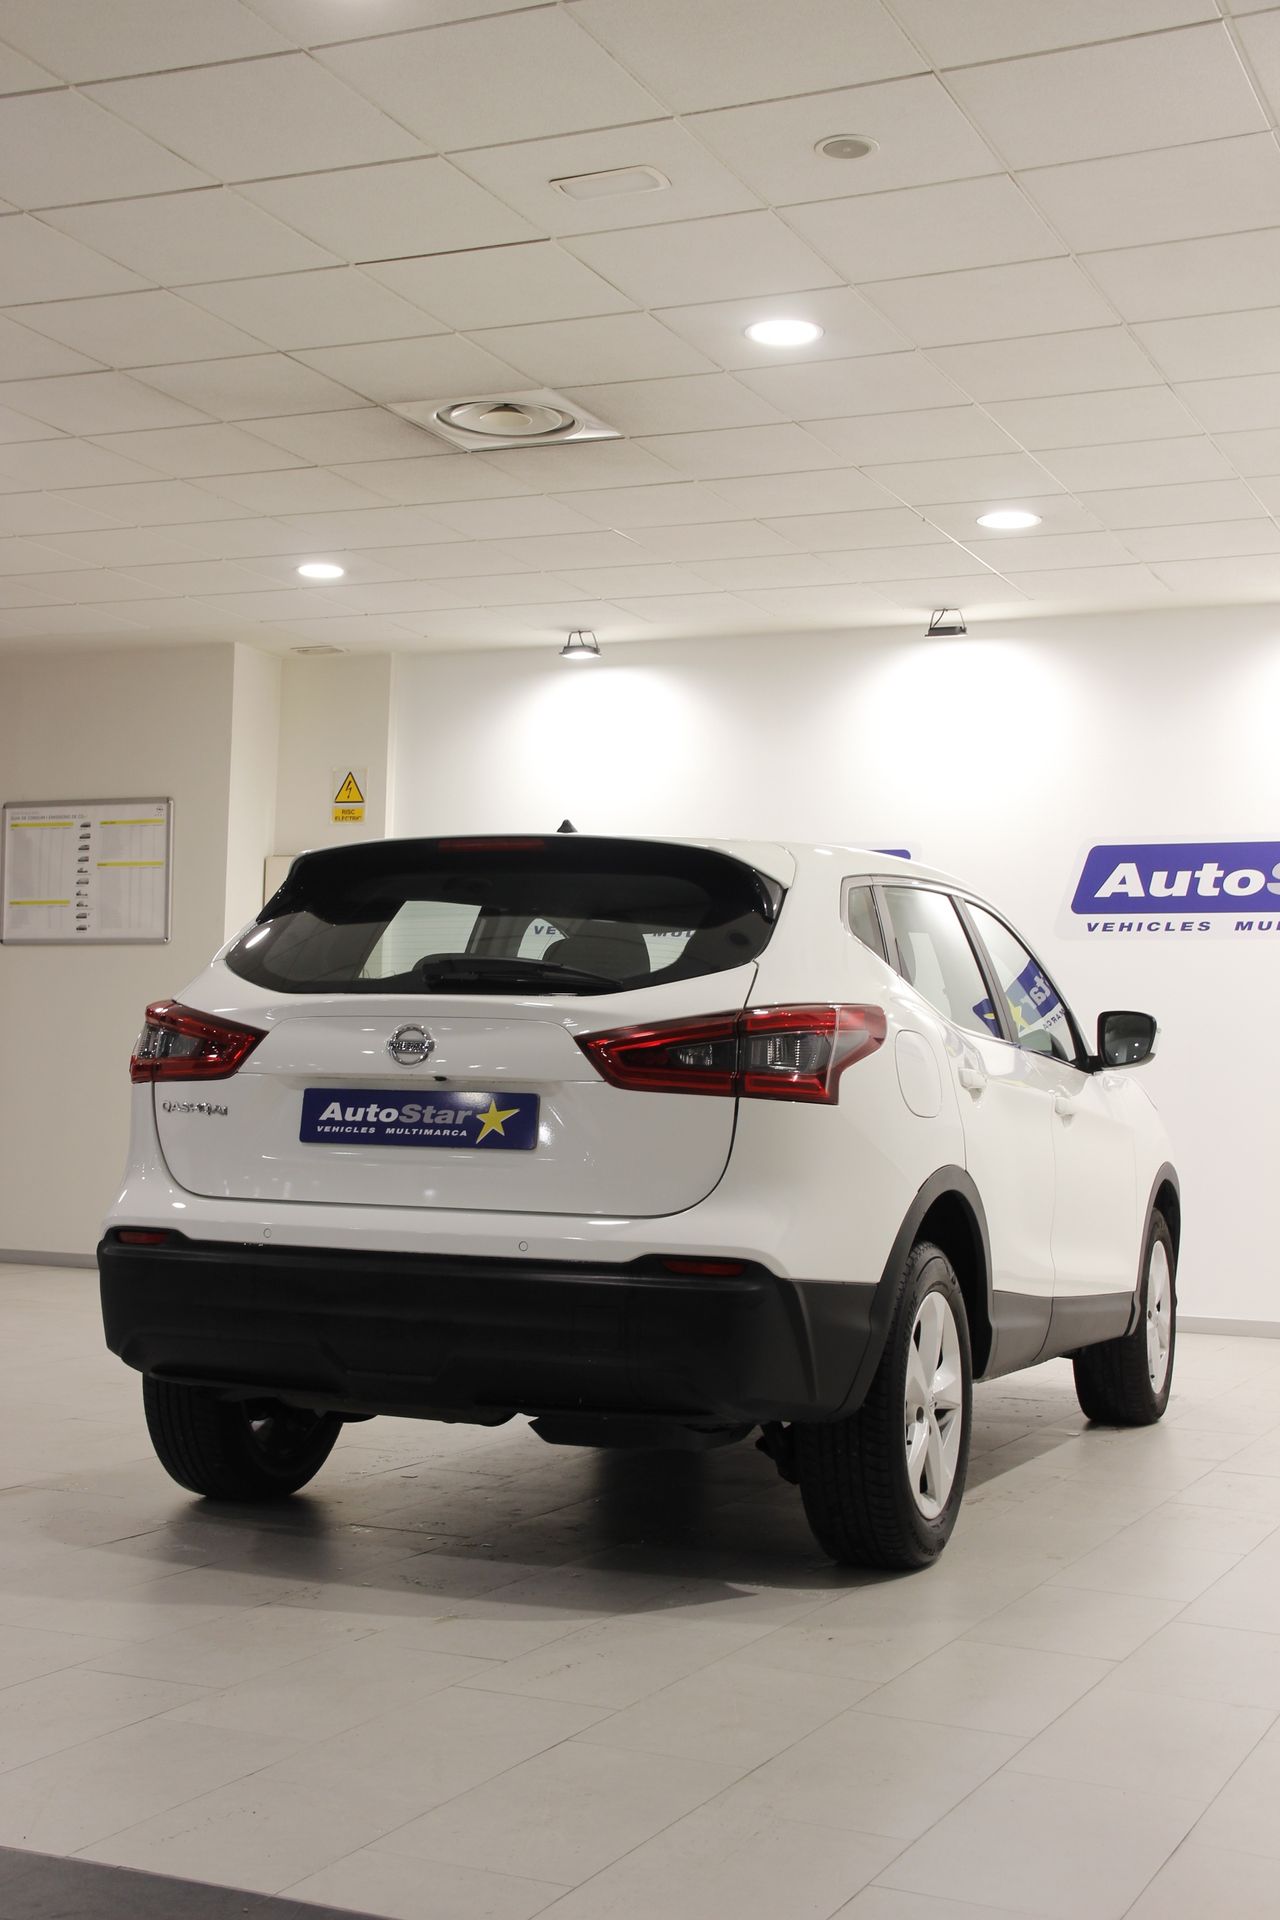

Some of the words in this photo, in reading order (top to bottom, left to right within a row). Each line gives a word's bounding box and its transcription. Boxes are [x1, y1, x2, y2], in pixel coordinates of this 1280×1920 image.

[1086, 921, 1212, 932] VEHICLES
[319, 1101, 473, 1125] AutoStar
[316, 1125, 376, 1134] VEHICLES
[385, 1127, 468, 1137] MULTIMARCA
